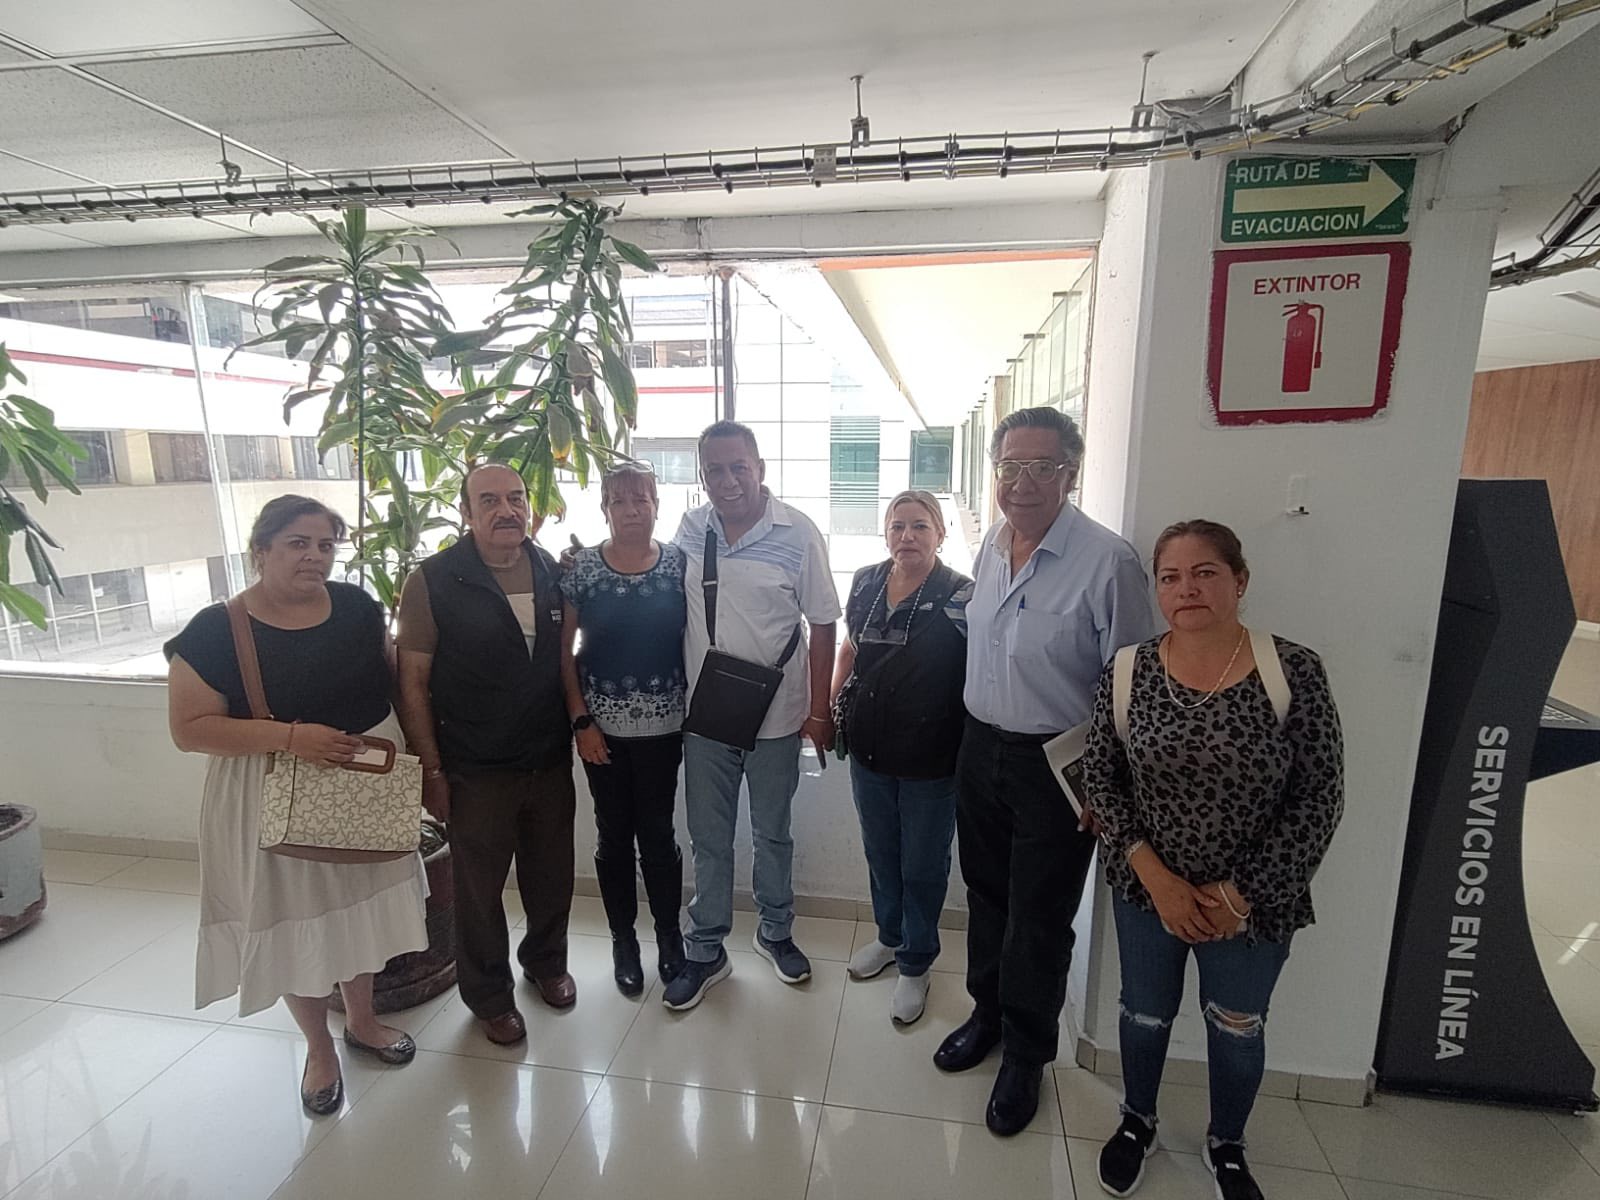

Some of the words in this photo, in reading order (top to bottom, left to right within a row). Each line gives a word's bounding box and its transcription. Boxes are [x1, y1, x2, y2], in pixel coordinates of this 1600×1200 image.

[1236, 162, 1288, 183] RUTA
[1294, 162, 1321, 180] DE
[1231, 213, 1360, 236] EVACUACION
[1254, 273, 1361, 294] EXTINTOR
[1455, 726, 1509, 906] SERVICIOS
[1447, 916, 1481, 960] EN
[1435, 969, 1479, 1061] LÍNEA
